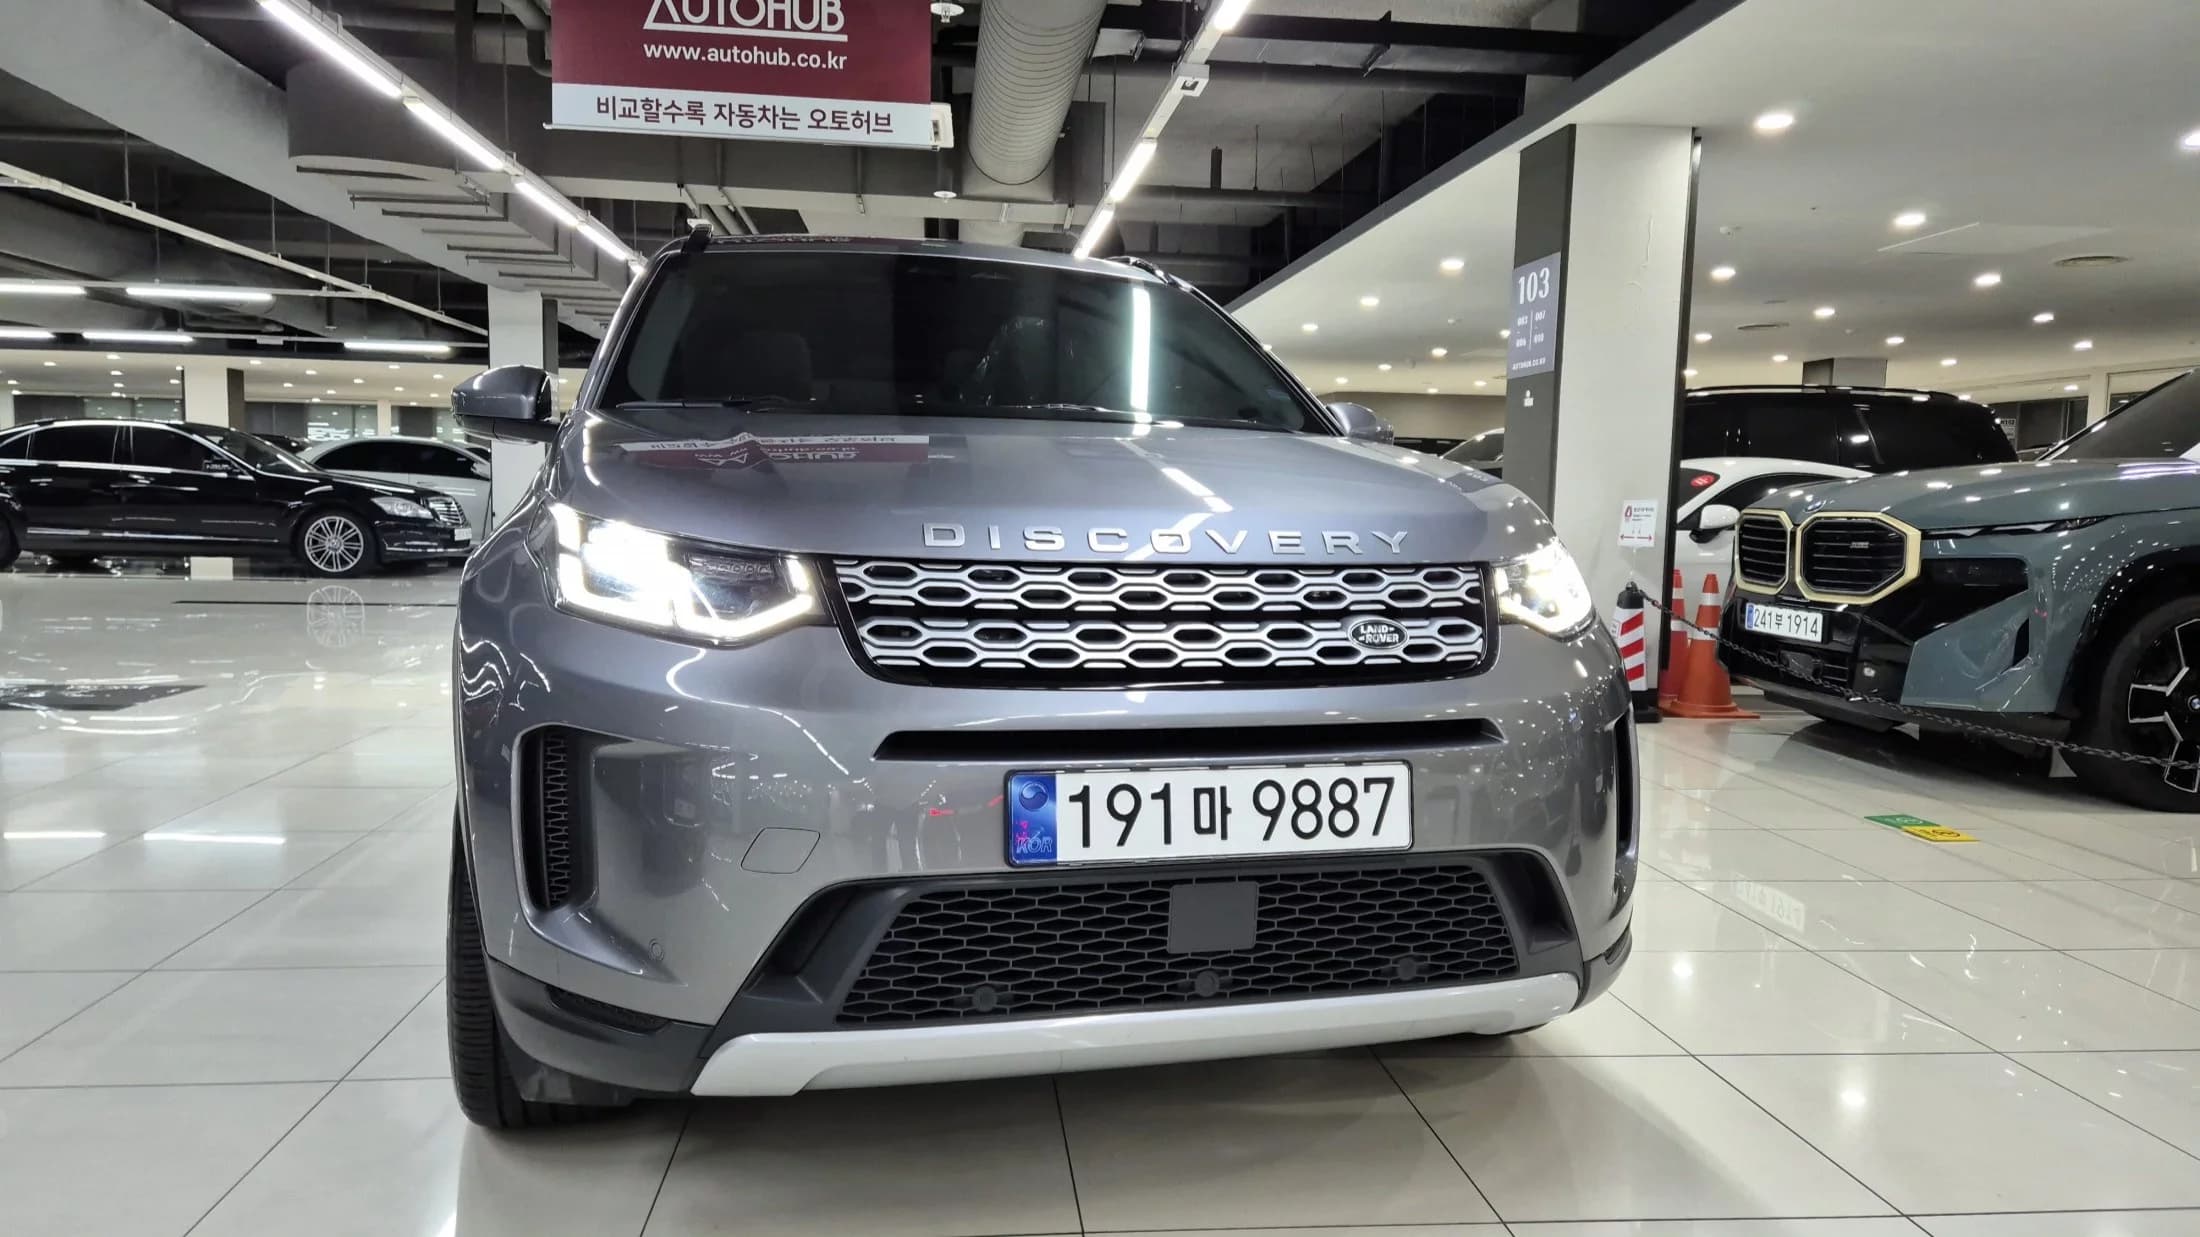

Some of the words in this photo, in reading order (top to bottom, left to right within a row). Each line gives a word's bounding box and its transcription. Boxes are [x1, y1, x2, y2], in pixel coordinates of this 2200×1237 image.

[643, 43, 848, 70] www.autohub.co.kr
[596, 96, 706, 125] 비교할수록
[713, 102, 800, 130] 자동차는
[807, 108, 894, 135] 오토허브
[1518, 267, 1550, 304] 103
[923, 522, 1409, 555] DISCOVERY
[1365, 633, 1399, 643] ROVER
[1754, 608, 1783, 630] 241부
[1787, 613, 1818, 638] 1914
[1068, 782, 1232, 849] 191마
[1252, 776, 1395, 841] 9887
